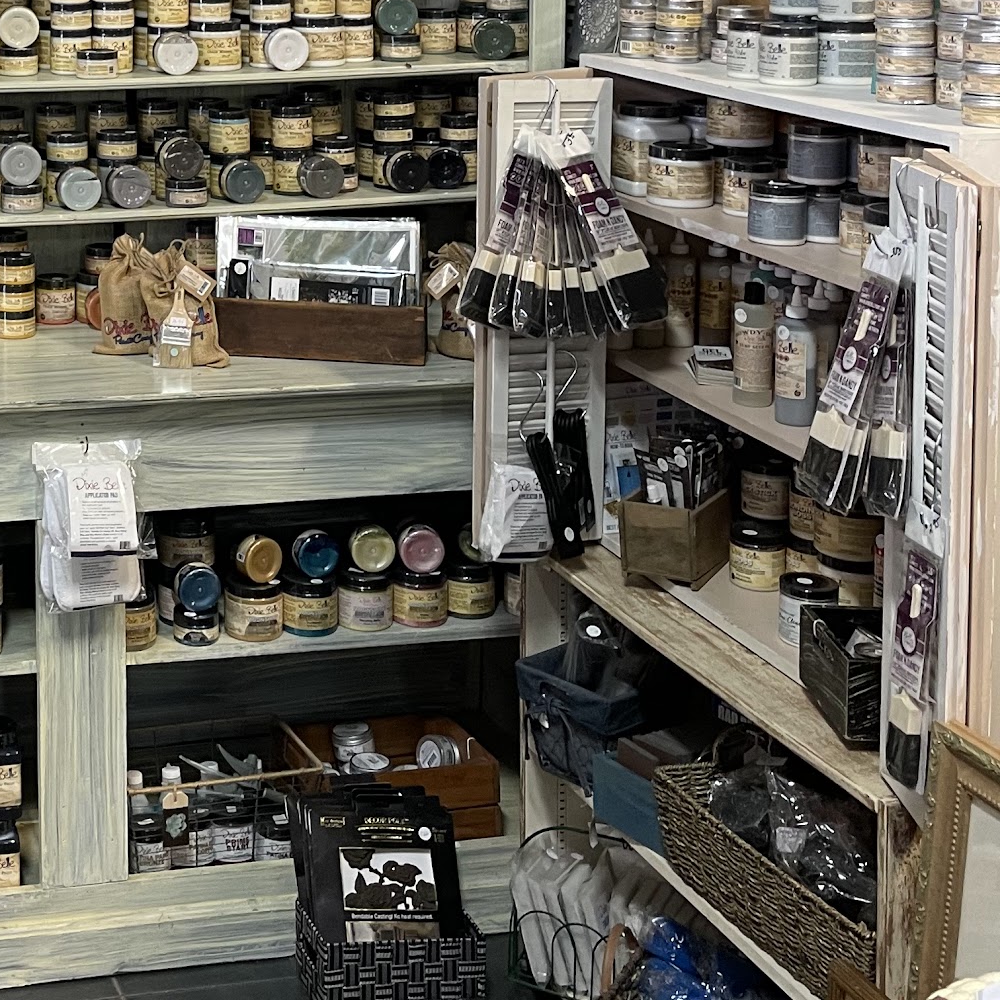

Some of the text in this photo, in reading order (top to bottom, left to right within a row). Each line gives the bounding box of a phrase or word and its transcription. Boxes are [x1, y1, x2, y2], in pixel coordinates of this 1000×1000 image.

[157, 0, 176, 7] Dixie
[423, 24, 440, 34] Dixie
[207, 39, 226, 49] Dixie
[312, 35, 331, 44] Dixie
[736, 39, 756, 50] Belle
[767, 43, 787, 55] Belle
[717, 105, 737, 117] Belle
[278, 120, 295, 130] Dixie
[225, 126, 244, 136] Dixie
[655, 166, 674, 177] Belle
[727, 177, 747, 189] Belle
[42, 294, 60, 304] Dixie
[104, 318, 137, 335] Dixie
[778, 340, 800, 354] Belle
[73, 477, 100, 490] Dixie
[508, 478, 532, 492] Dixie
[248, 606, 265, 615] Dixie
